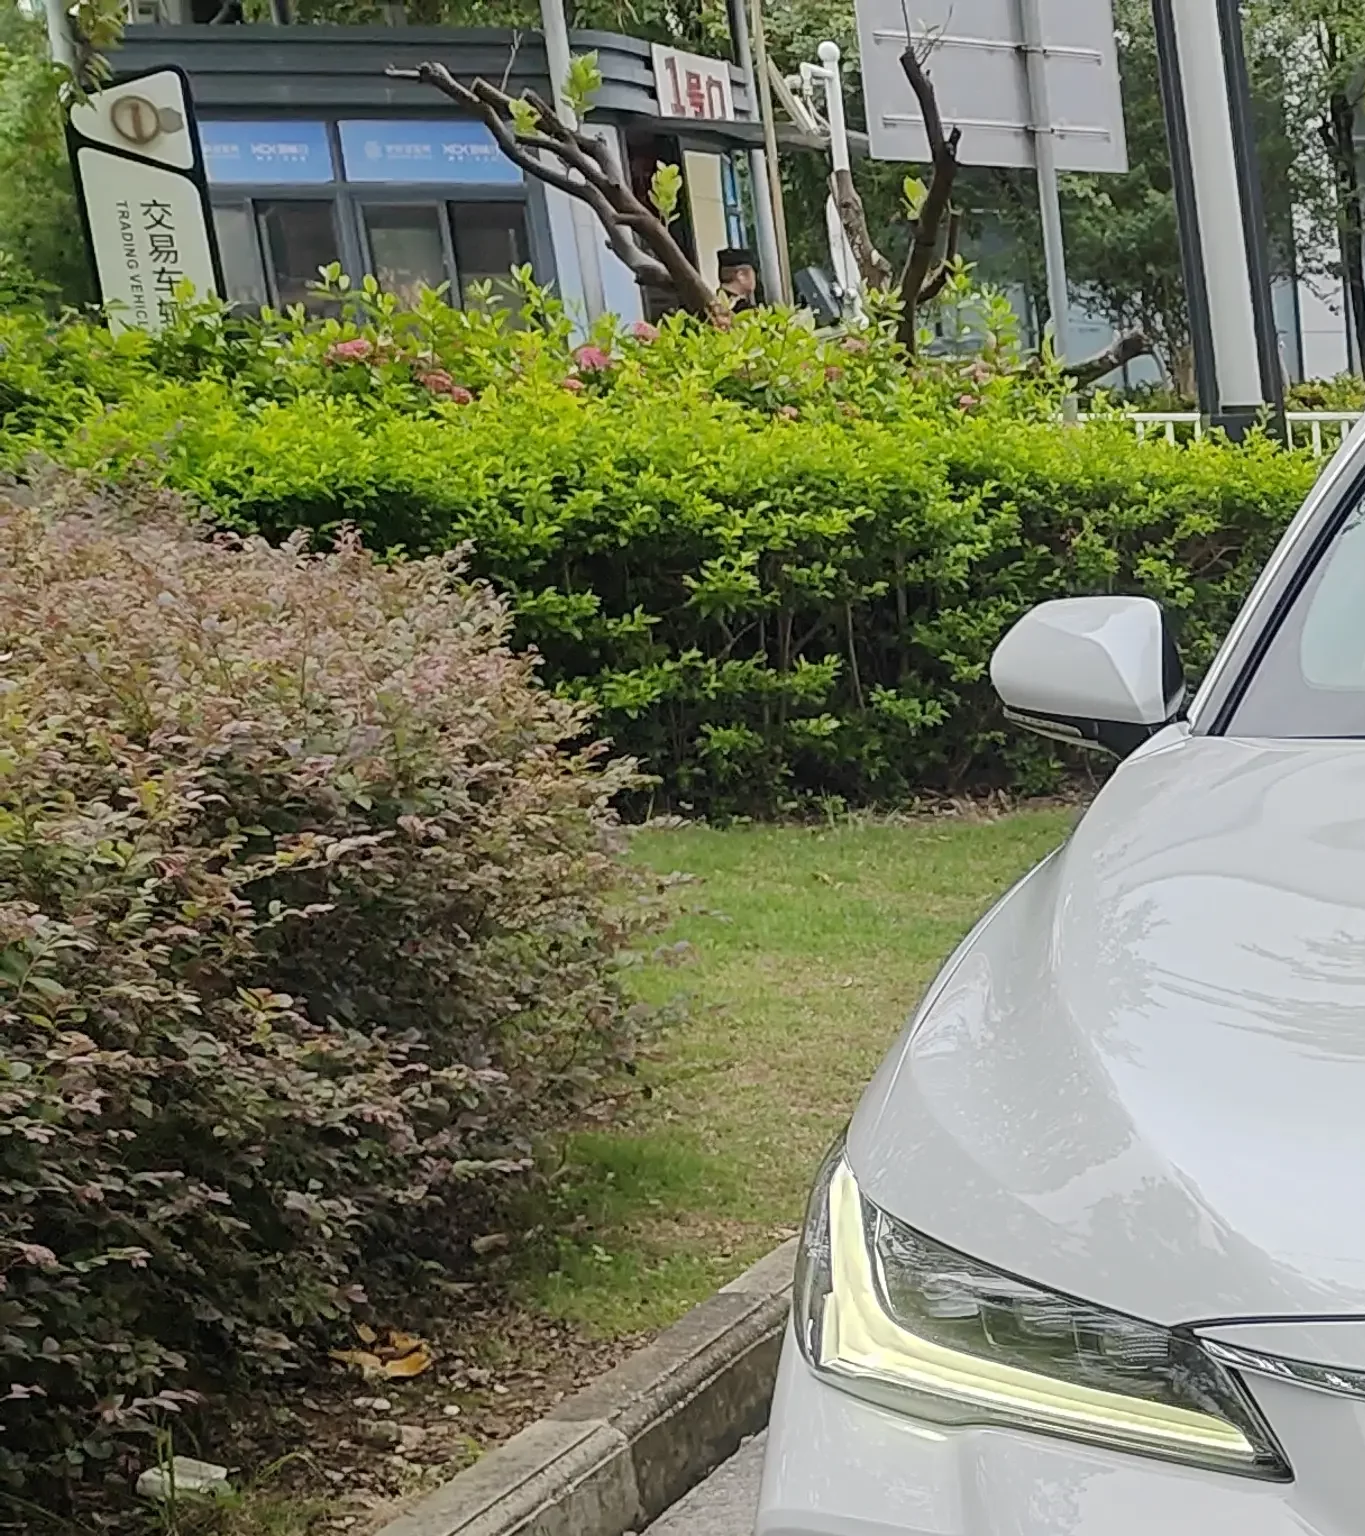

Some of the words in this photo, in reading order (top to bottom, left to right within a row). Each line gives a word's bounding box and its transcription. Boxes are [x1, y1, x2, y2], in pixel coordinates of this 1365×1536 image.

[664, 56, 727, 119] 1号门
[115, 200, 139, 270] TRADING
[129, 274, 149, 327] VEHICL
